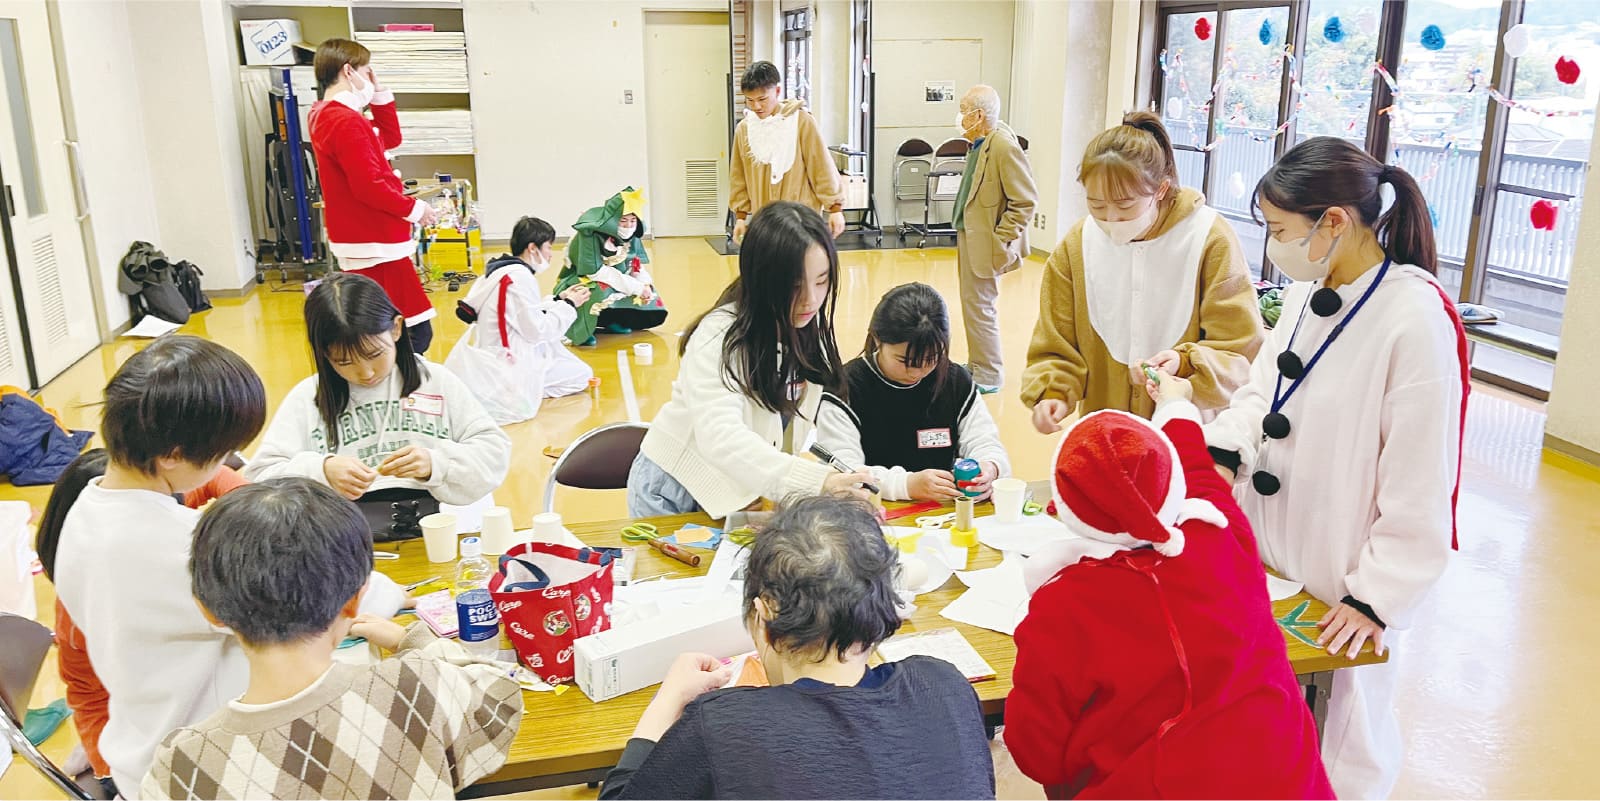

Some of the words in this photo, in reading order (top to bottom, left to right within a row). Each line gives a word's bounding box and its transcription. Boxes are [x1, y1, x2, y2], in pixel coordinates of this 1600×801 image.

[260, 31, 288, 54] 0123
[311, 400, 449, 451] CRNWALL
[541, 587, 571, 599] Carp
[499, 600, 522, 612] Carp
[510, 622, 535, 639] Carp
[556, 645, 575, 664] Car
